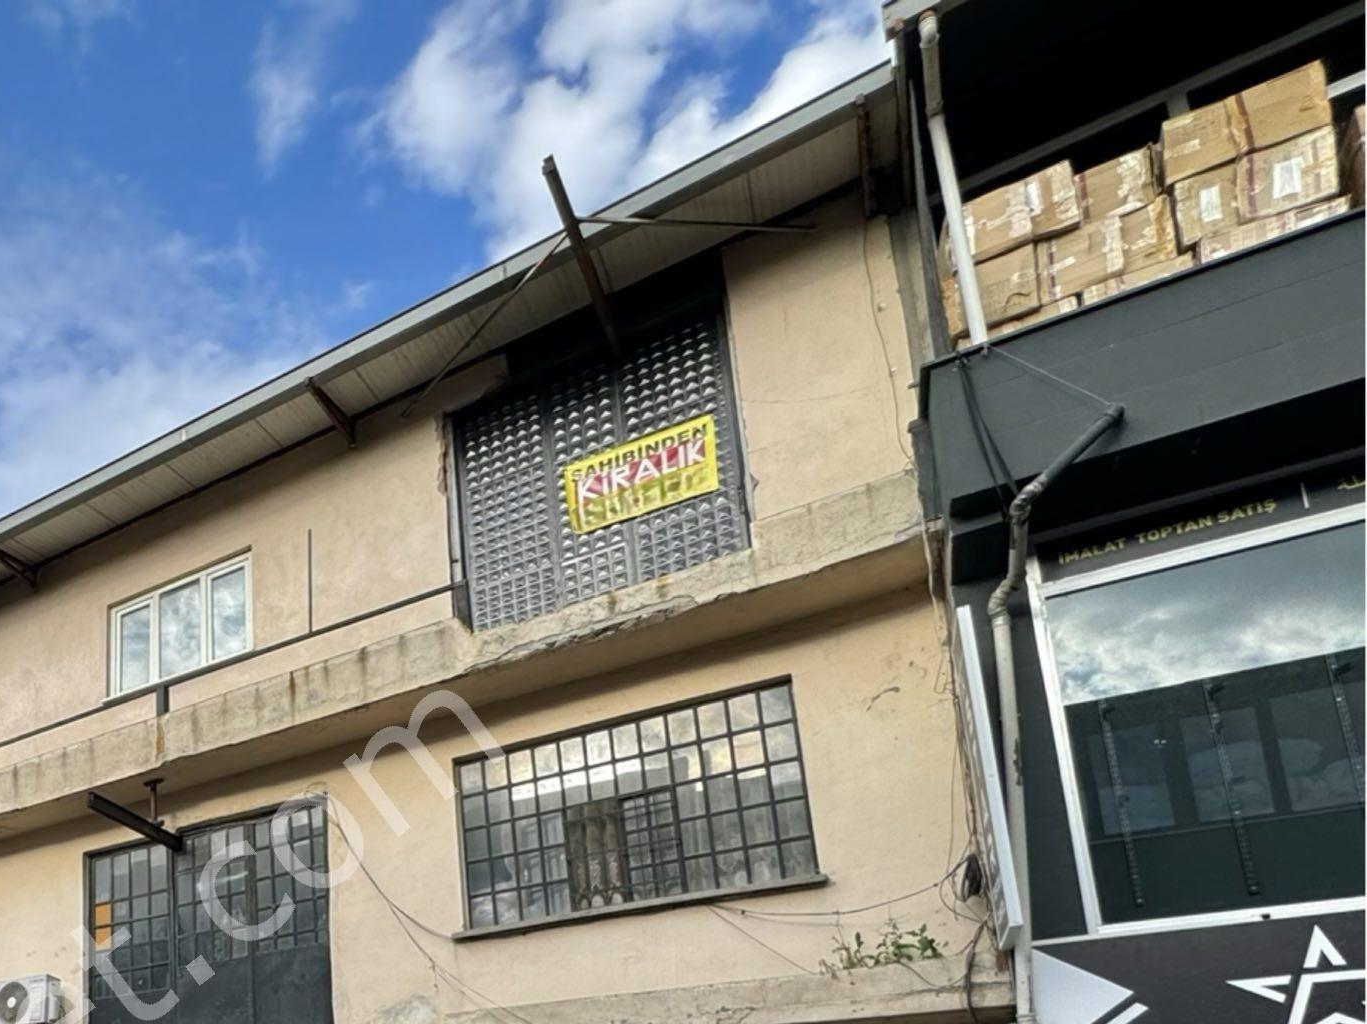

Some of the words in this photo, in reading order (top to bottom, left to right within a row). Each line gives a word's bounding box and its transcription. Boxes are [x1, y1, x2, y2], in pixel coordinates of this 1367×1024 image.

[577, 438, 706, 500] KİRALIK
[1058, 537, 1127, 565] İMALAT
[1137, 517, 1213, 545] TOPTAN
[1217, 498, 1277, 525] SATIŞ
